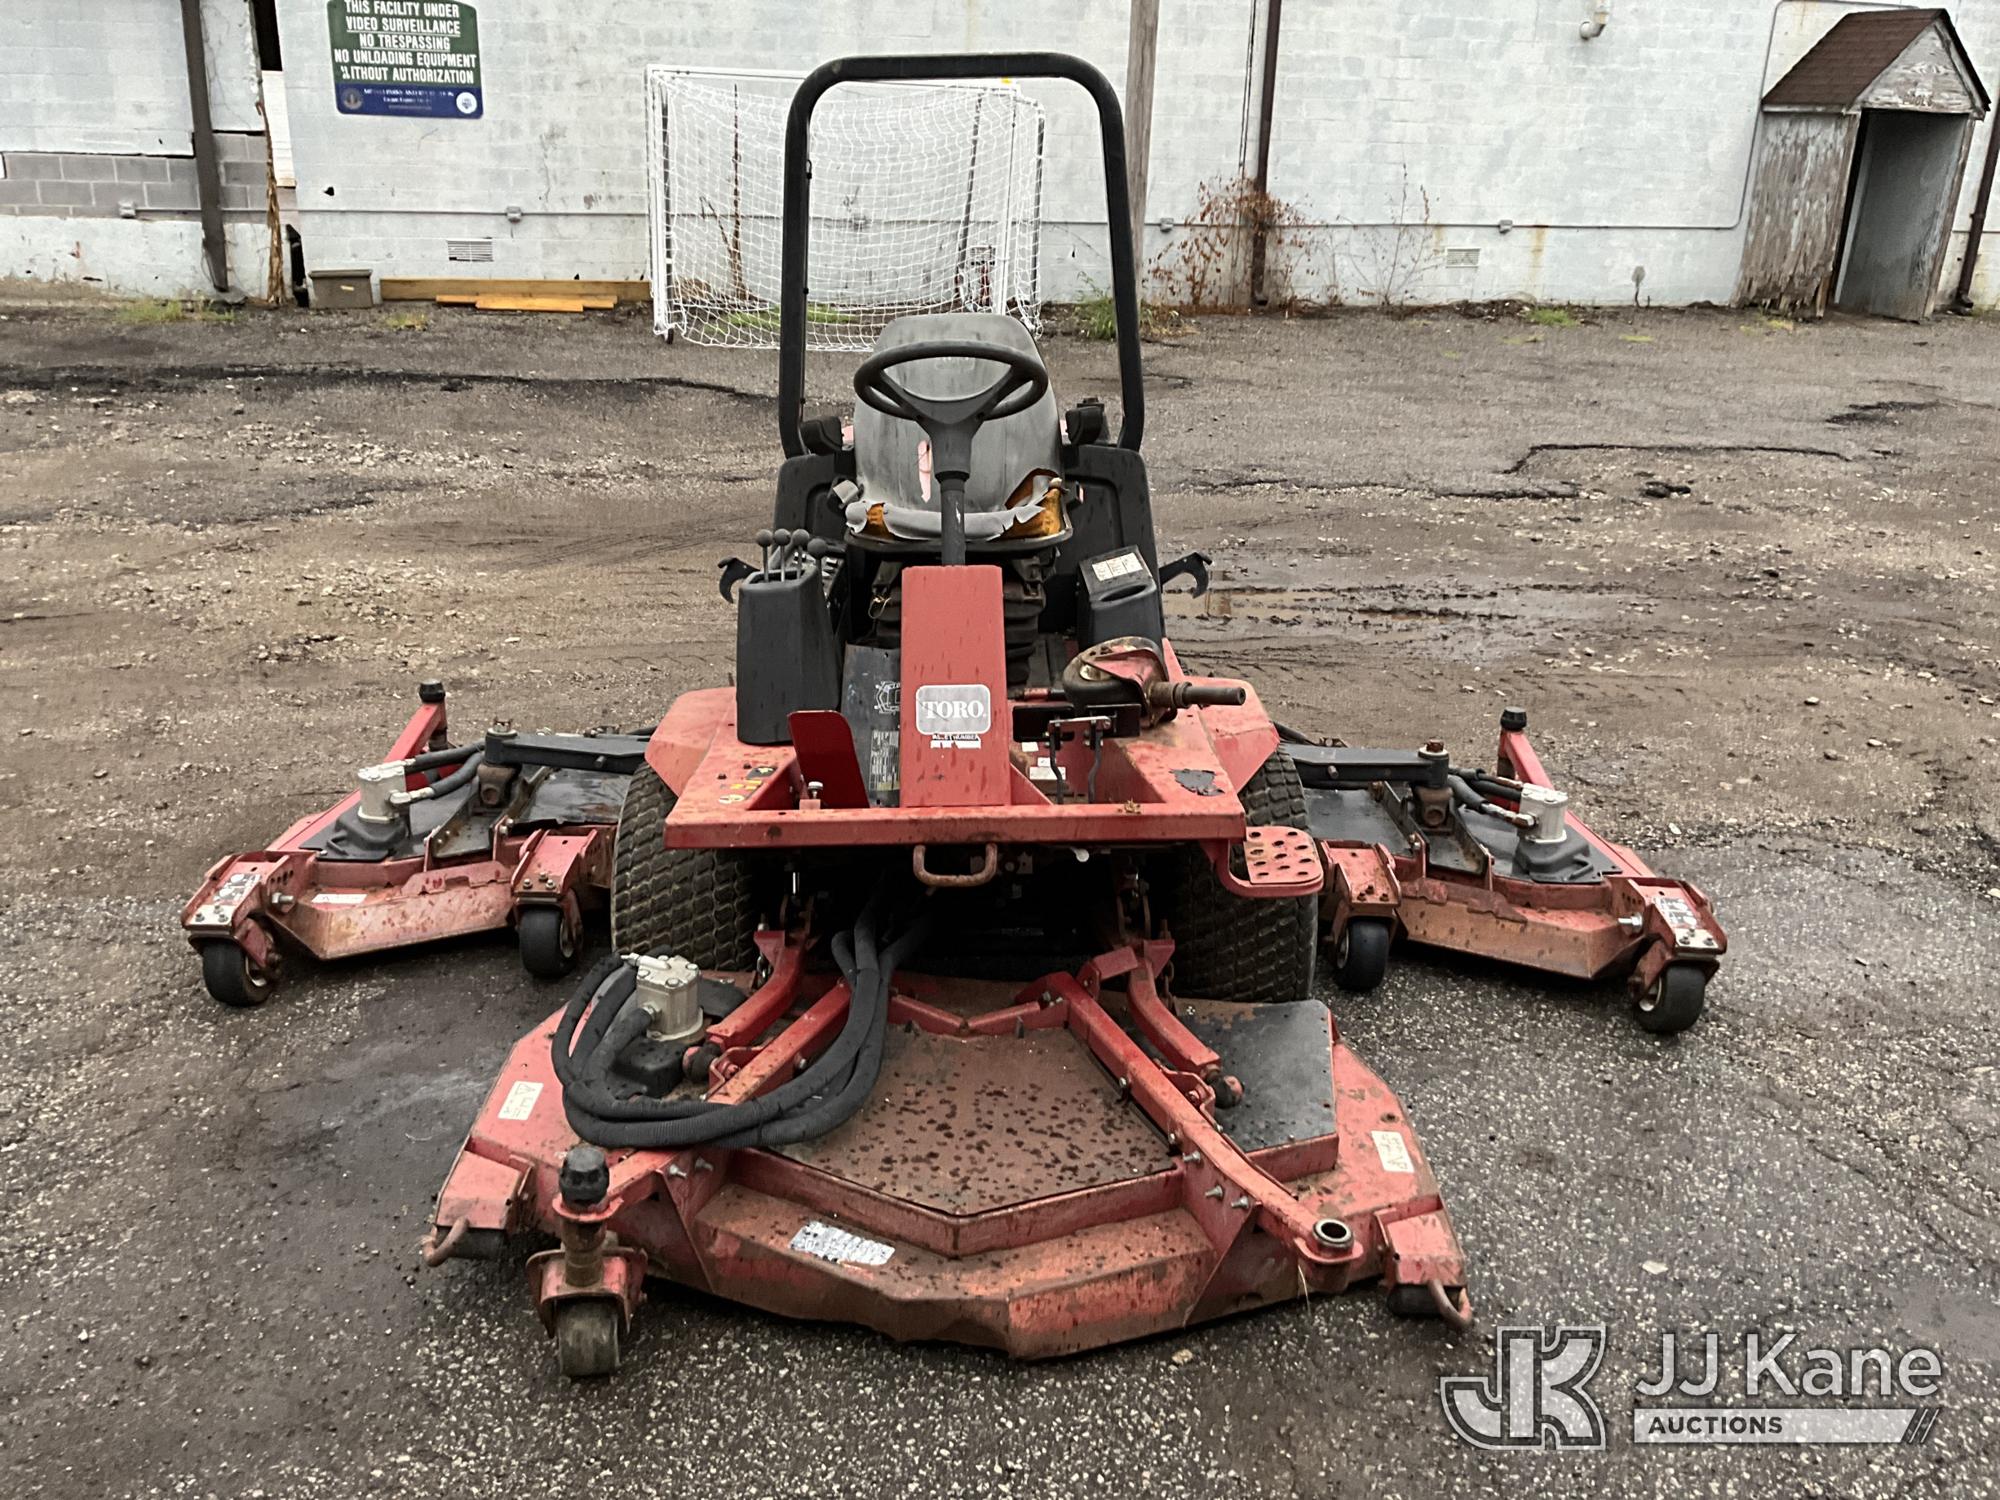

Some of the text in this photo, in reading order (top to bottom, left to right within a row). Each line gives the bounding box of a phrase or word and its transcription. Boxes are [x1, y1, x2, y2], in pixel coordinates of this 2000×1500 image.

[344, 0, 460, 18] THIS FACILITY UNDER
[346, 16, 461, 34] VIDEO SURVEILLANCE
[359, 33, 450, 50] NO TRESPASSING
[334, 49, 477, 68] NO UNLOADING EQUIPMENT
[392, 67, 474, 84] AUTHORIZATION
